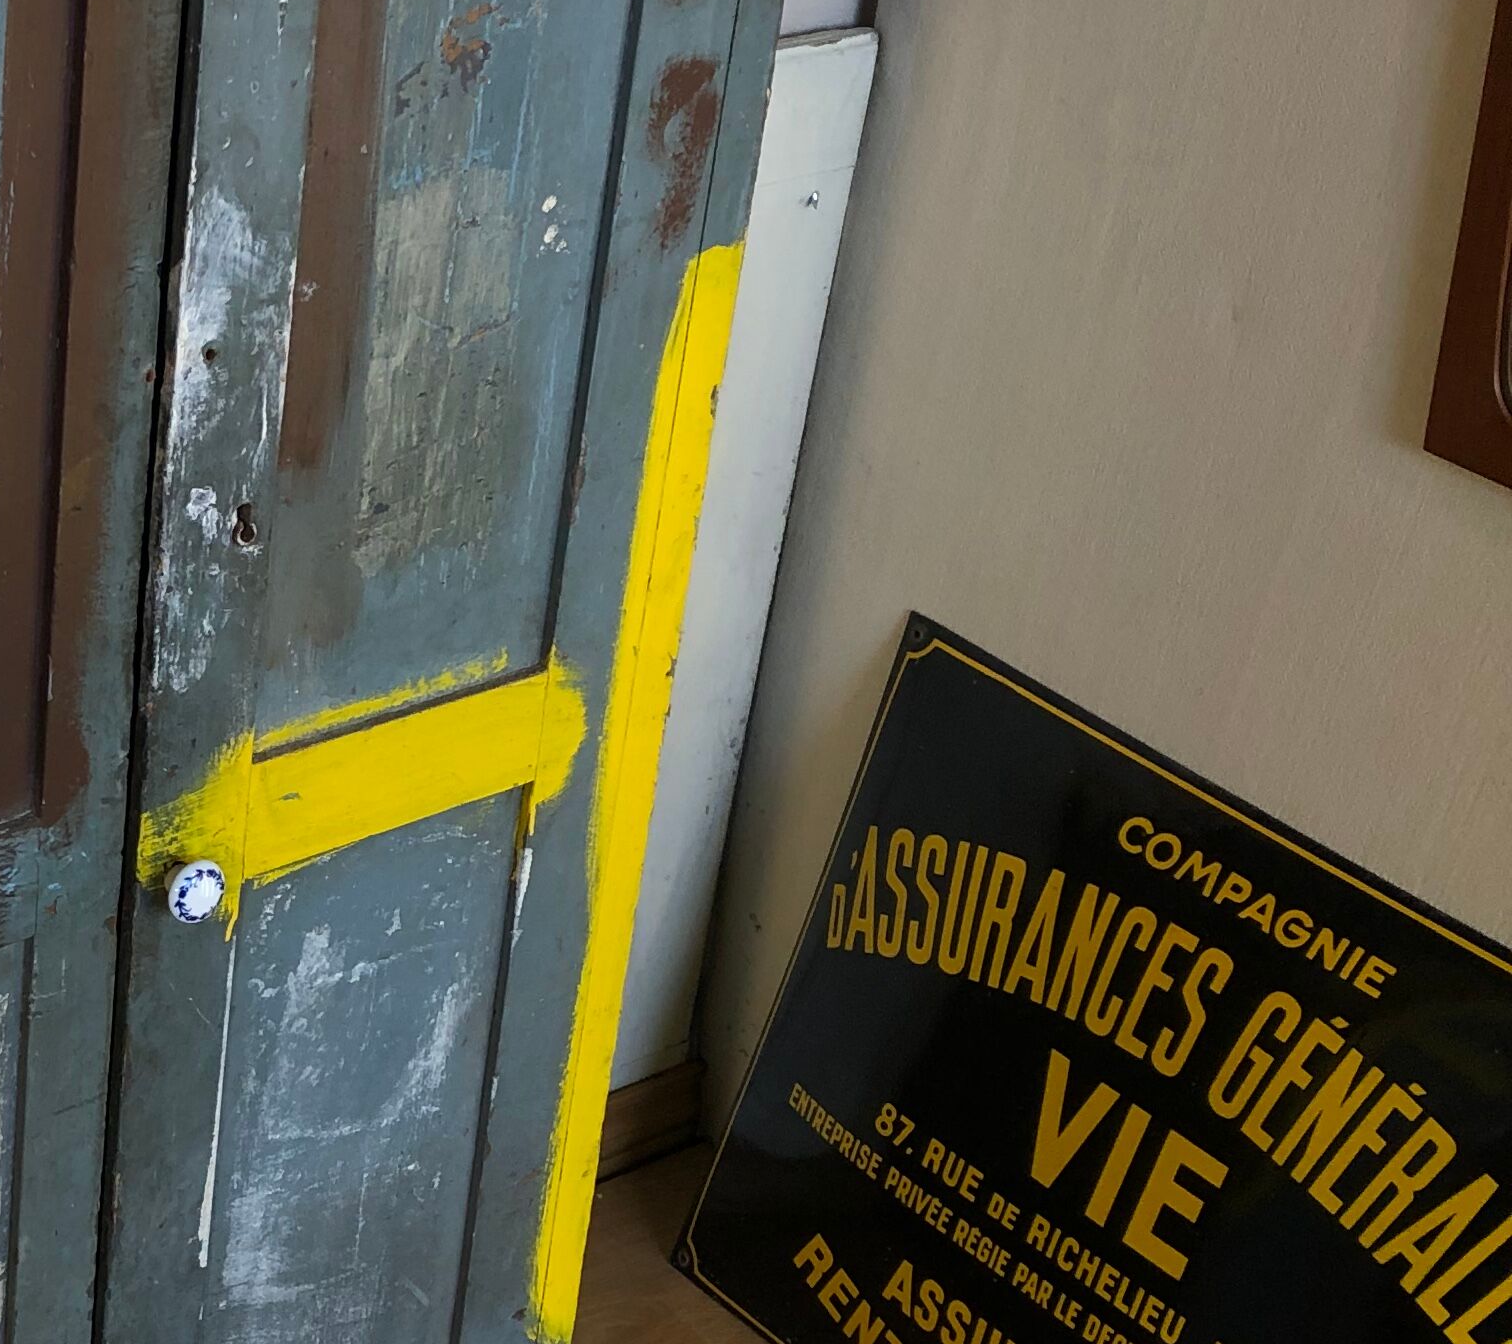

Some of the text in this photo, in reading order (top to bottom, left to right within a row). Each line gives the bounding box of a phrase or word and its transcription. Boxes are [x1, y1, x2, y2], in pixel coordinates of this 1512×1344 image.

[1117, 815, 1397, 999] COMPAGNIE
[788, 1082, 883, 1180] ENTREPRISE
[884, 1166, 954, 1235] PRIVÉE
[952, 1218, 1012, 1278] RÉGIE
[1012, 1262, 1054, 1310] PAR
[1053, 1293, 1083, 1330] LE
[921, 1137, 984, 1202] RUE
[987, 1192, 1021, 1231] DE
[1030, 1048, 1229, 1281] VIE
